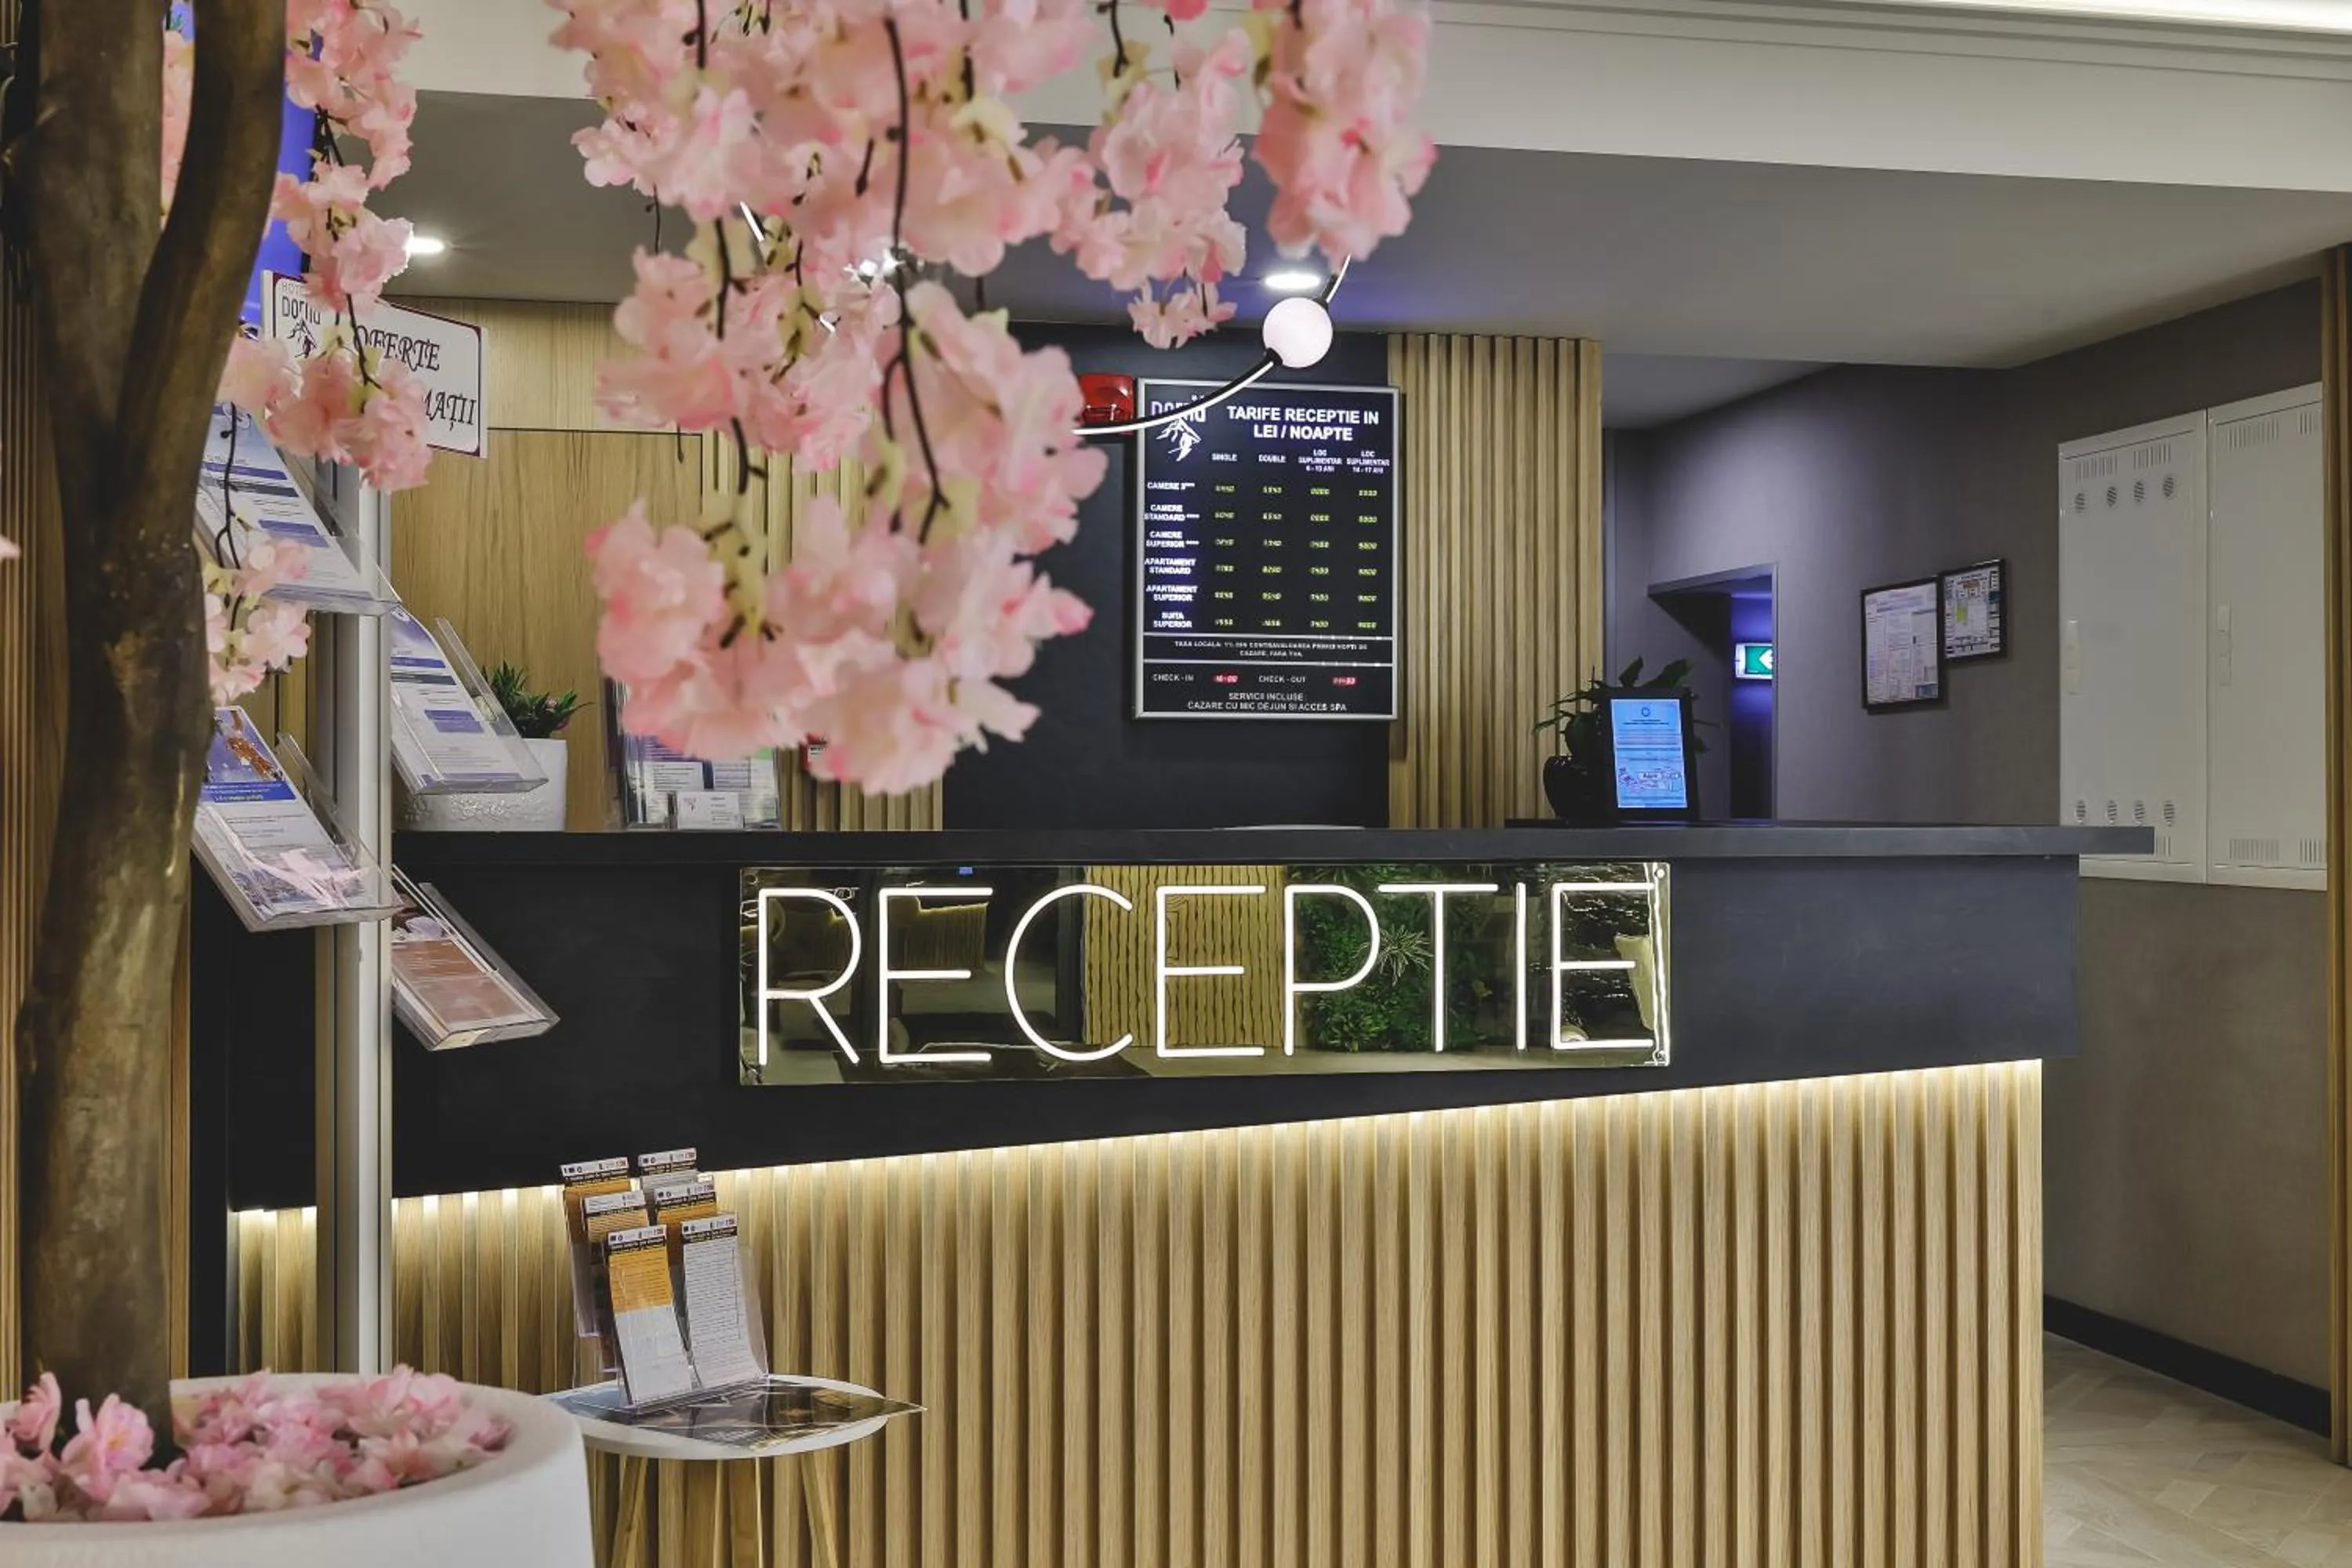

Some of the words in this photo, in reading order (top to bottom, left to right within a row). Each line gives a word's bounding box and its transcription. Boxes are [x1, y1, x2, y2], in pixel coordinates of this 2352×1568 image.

[281, 282, 309, 295] HOTE
[1227, 405, 1280, 421] TARIFE
[1285, 407, 1360, 424] RECEPTIE
[1363, 411, 1379, 424] IN
[1254, 424, 1278, 438] LEI
[1280, 425, 1287, 439] /
[1290, 426, 1353, 441] NOAPTE
[1258, 454, 1287, 463] DOUBLE
[1266, 692, 1304, 701] INCLUSE
[757, 881, 1655, 1066] RECEPTIE
